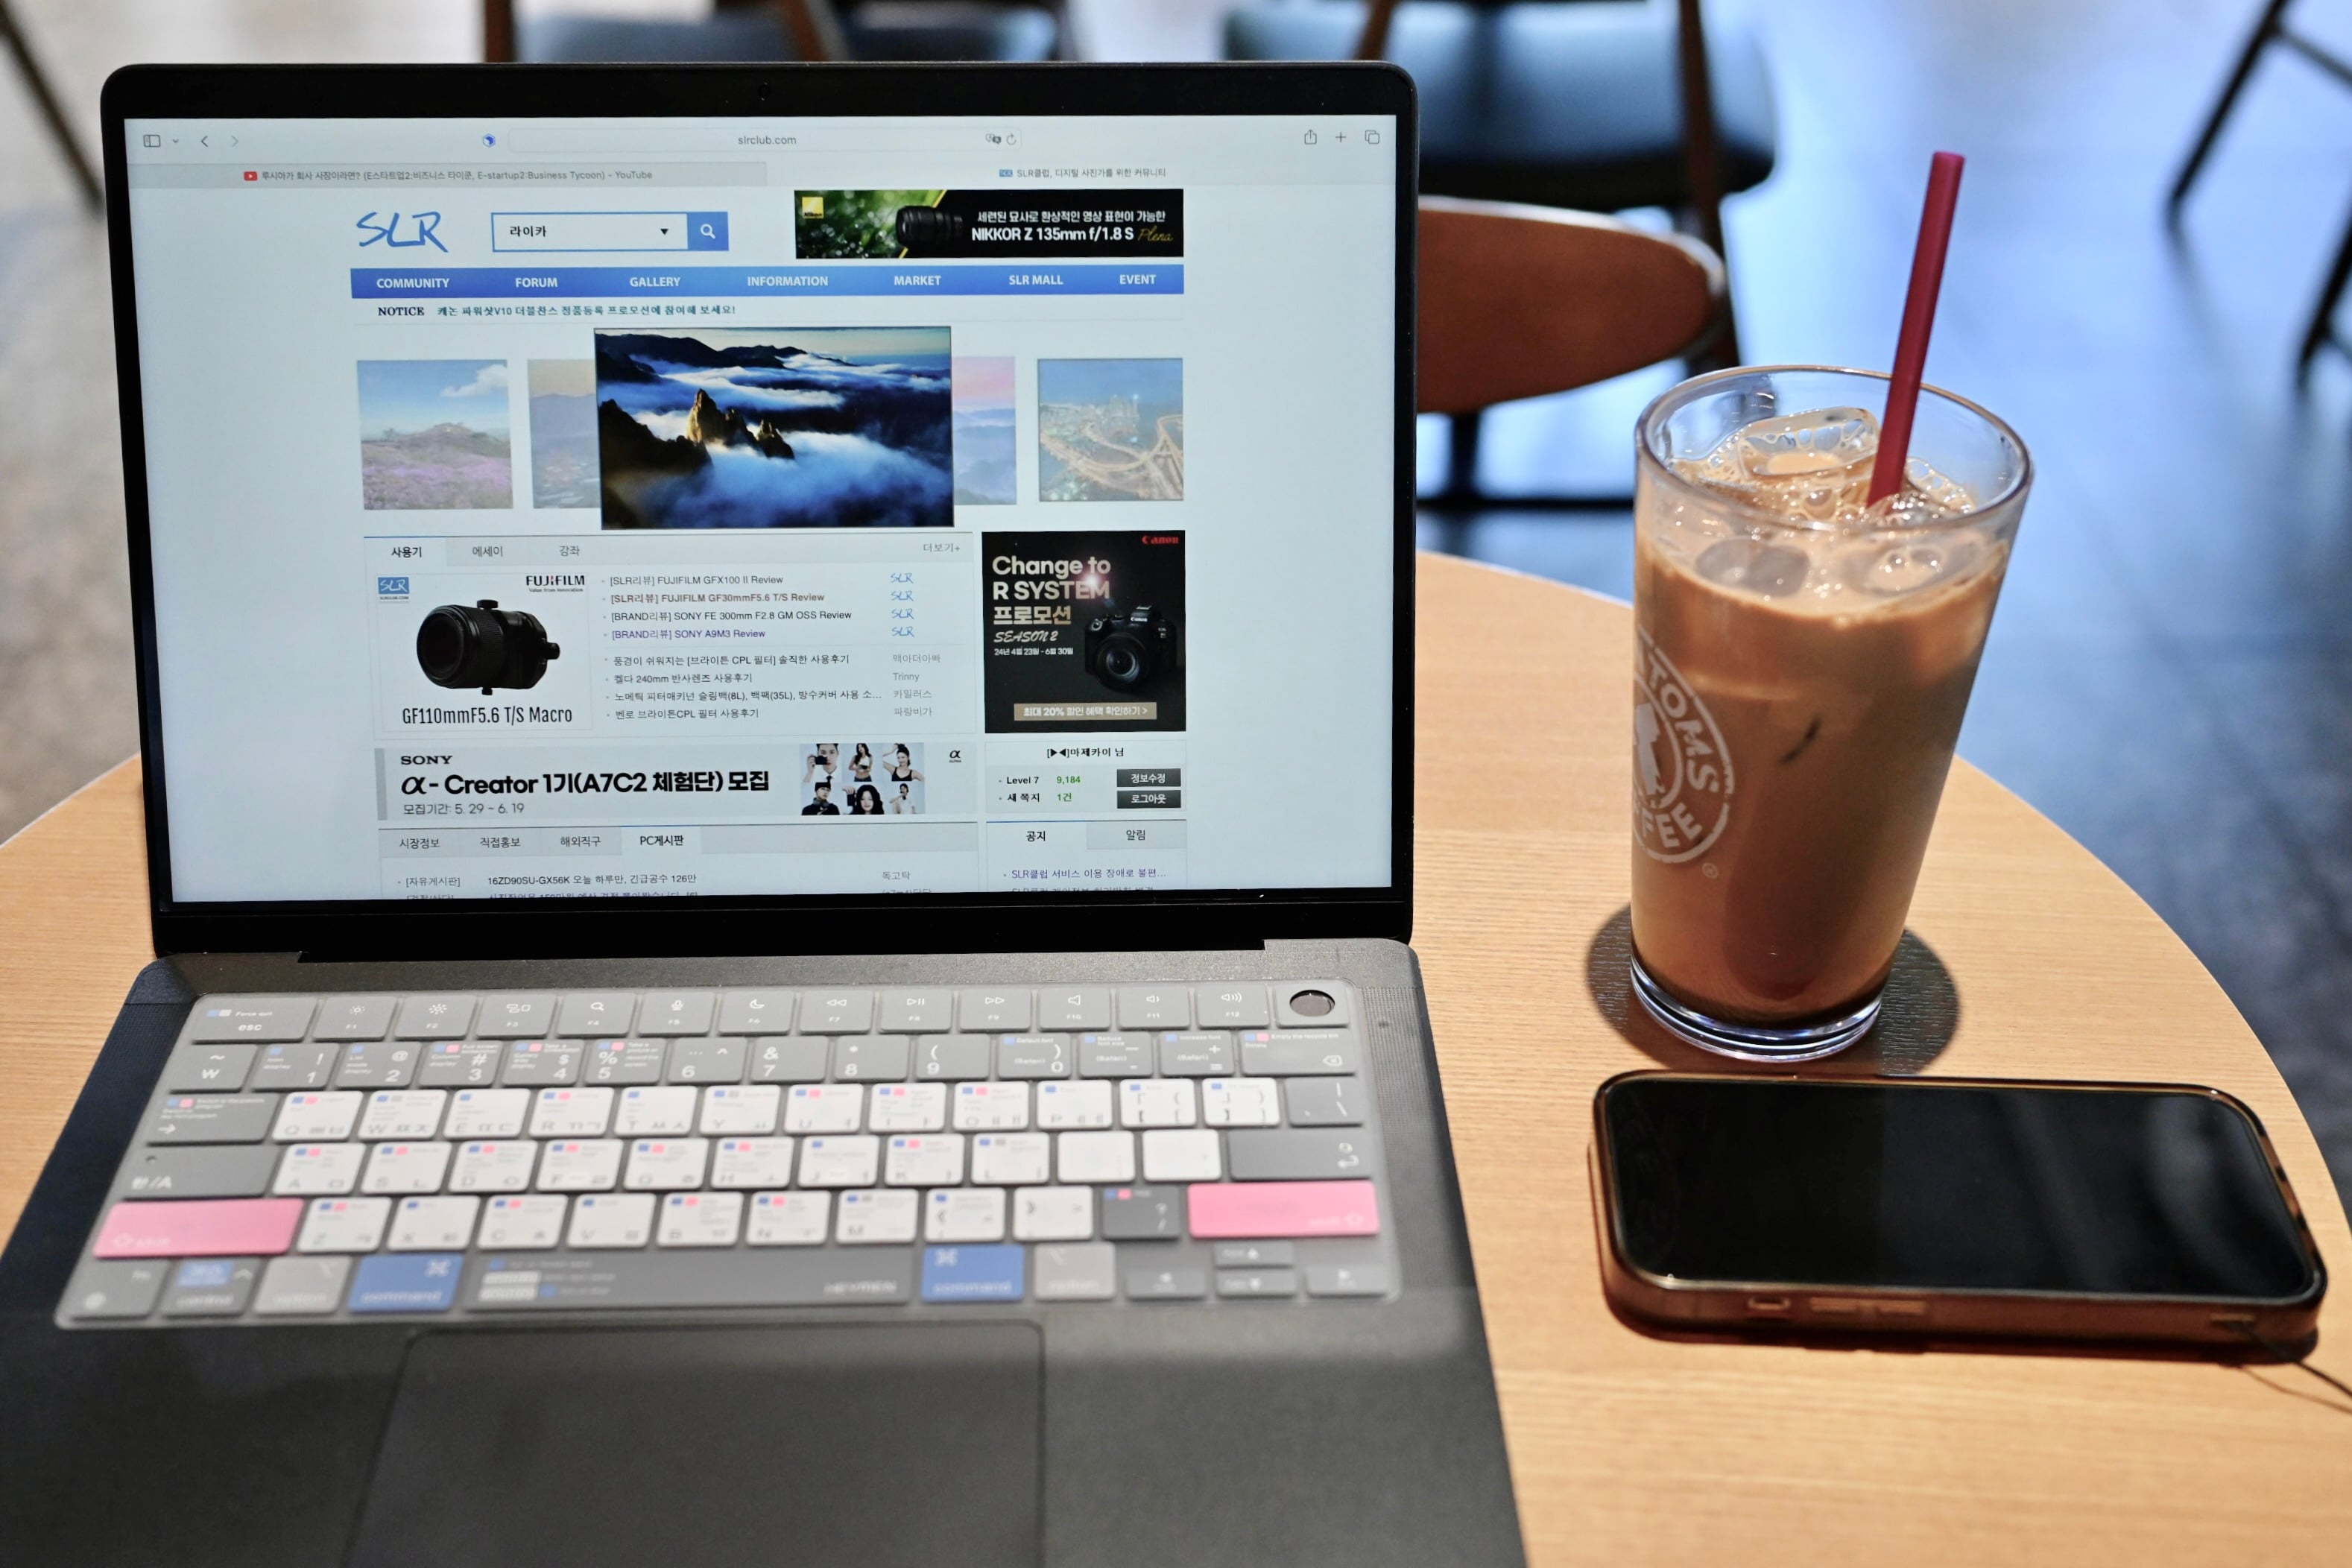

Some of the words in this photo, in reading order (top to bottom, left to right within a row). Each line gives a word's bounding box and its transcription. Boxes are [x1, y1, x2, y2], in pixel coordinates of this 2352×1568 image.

[738, 135, 797, 145] slrclub.com
[569, 171, 605, 181] Tycoon)
[614, 170, 653, 180] YouTube
[1055, 168, 1079, 178] 디지털
[1081, 168, 1113, 178] 사진가를
[1116, 168, 1132, 178] 위한
[1134, 168, 1166, 178] 커뮤니티
[978, 212, 1006, 223] 세련된
[1010, 211, 1038, 222] 묘사로
[1042, 211, 1080, 223] 환상적인
[1083, 211, 1102, 222] 영상
[1105, 211, 1134, 222] 표현이
[1137, 211, 1166, 222] 가능한
[356, 211, 449, 253] SLR
[510, 226, 546, 237] 라이카
[972, 227, 1021, 241] NIKKOR
[1024, 227, 1033, 241] Z
[1037, 227, 1086, 240] 135mm
[1089, 227, 1122, 241] f/1.8
[1125, 227, 1134, 240] S
[376, 277, 450, 288] COMMUNITY
[515, 277, 558, 288] FORUM
[629, 276, 681, 288] GALLERY
[747, 275, 829, 287] INFORMATION
[894, 275, 942, 286] MARKET
[1008, 275, 1029, 285] SLR
[1031, 274, 1064, 285] MALL
[1119, 274, 1157, 285] EVENT
[378, 306, 425, 317] NOTICE
[462, 306, 513, 317] 파워샷V10
[515, 306, 558, 317] 더블찬스
[561, 305, 604, 316] 정품등록
[607, 305, 661, 316] 프로모션에
[664, 305, 697, 316] 참여해
[701, 305, 736, 315] 보세요!
[1141, 535, 1179, 545] Canon
[391, 546, 422, 558] 사용기
[472, 546, 503, 557] 에세이
[560, 545, 581, 557] 강좌
[992, 556, 1083, 579] Change
[1087, 557, 1111, 574] to
[380, 578, 409, 592] SLR
[525, 575, 585, 587] FUJIFILM
[610, 575, 655, 587] [SLR리뷰]
[657, 576, 701, 585] FUJIFILM
[703, 575, 741, 585] GFX100
[742, 575, 748, 584] II
[750, 575, 784, 584] Review
[993, 581, 1008, 600] R
[1014, 581, 1110, 599] SYSTEM
[610, 593, 659, 605] [SLR리뷰]
[661, 593, 706, 603] FUJIFILM
[708, 593, 771, 602] GF30mmF5.6
[772, 592, 788, 601] T/S
[791, 592, 825, 601] Review
[611, 611, 671, 623] [BRAND리뷰]
[674, 612, 702, 621] SONY
[704, 611, 717, 620] FE
[719, 612, 753, 621] 300mm
[755, 611, 775, 620] F2.8
[777, 611, 794, 620] GM
[795, 610, 818, 620] OSS
[819, 610, 853, 619] Review
[993, 606, 1071, 625] 프로모션
[612, 629, 672, 641] [BRAND리뷰]
[674, 630, 703, 639] SONY
[704, 629, 731, 638] A9M3
[733, 629, 766, 638] Review
[993, 630, 1049, 642] SEASON
[1049, 630, 1059, 642] 2
[993, 648, 1011, 656] 24년
[613, 656, 642, 667] 풍경이
[645, 656, 685, 666] 쉬워지는
[686, 655, 729, 667] [브라이튼
[732, 656, 752, 665] CPL
[753, 655, 776, 666] 필터]
[778, 655, 807, 665] 솔직한
[810, 654, 850, 665] 사용후기
[636, 674, 669, 683] 240mm
[671, 673, 711, 684] 반사렌즈
[713, 673, 752, 683] 사용후기
[892, 671, 920, 683] Trinny
[615, 692, 644, 702] 노메틱
[698, 691, 748, 702] 슬링백(8L),
[798, 689, 837, 701] 방수커버
[840, 690, 859, 700] 사용
[402, 707, 499, 724] GF110mmF5.6
[504, 706, 524, 725] T/S
[530, 706, 572, 722] Macro
[615, 709, 635, 720] 벤로
[637, 709, 696, 719] 브라이튼CPL
[698, 709, 717, 719] 필터
[720, 708, 759, 718] 사용후기
[1043, 706, 1066, 717] 20%
[1114, 747, 1124, 757] 님
[400, 755, 453, 765] SONY
[445, 774, 538, 794] Creator
[543, 773, 647, 793] 1기(A7C2
[653, 771, 723, 791] 체험단)
[728, 771, 768, 791] 모집
[1006, 776, 1031, 785] Level
[1034, 776, 1040, 784] 7
[1056, 775, 1081, 785] 9,184
[1131, 774, 1166, 785] 정보수정
[1007, 792, 1017, 803] 새
[1020, 792, 1040, 803] 쪽지
[1057, 792, 1072, 803] 1건
[1131, 793, 1167, 804] 로그아웃
[403, 803, 452, 815] 모집기간:
[468, 803, 484, 815] 29
[511, 802, 525, 814] 19
[1026, 830, 1046, 842] 공지
[1125, 829, 1145, 841] 알림
[399, 838, 440, 850] 시장정보
[481, 837, 520, 848] 직접홍보
[560, 835, 601, 847] 해외직구
[639, 835, 684, 847] PC게시판
[1011, 869, 1048, 879] SLR클럽
[1052, 868, 1081, 879] 서비스
[1084, 868, 1103, 879] 이용
[1106, 867, 1135, 879] 장애로
[405, 876, 461, 888] [자유게시판]
[572, 875, 592, 885] 오늘
[595, 874, 627, 885] 하루만,
[630, 873, 668, 885] 긴급공수
[671, 873, 697, 883] 126만
[598, 1067, 610, 1079] 5
[764, 1064, 776, 1077] 7
[1051, 1061, 1063, 1073] 0
[308, 1072, 316, 1083] 1
[385, 1069, 400, 1082] 2
[554, 1068, 566, 1079] 4
